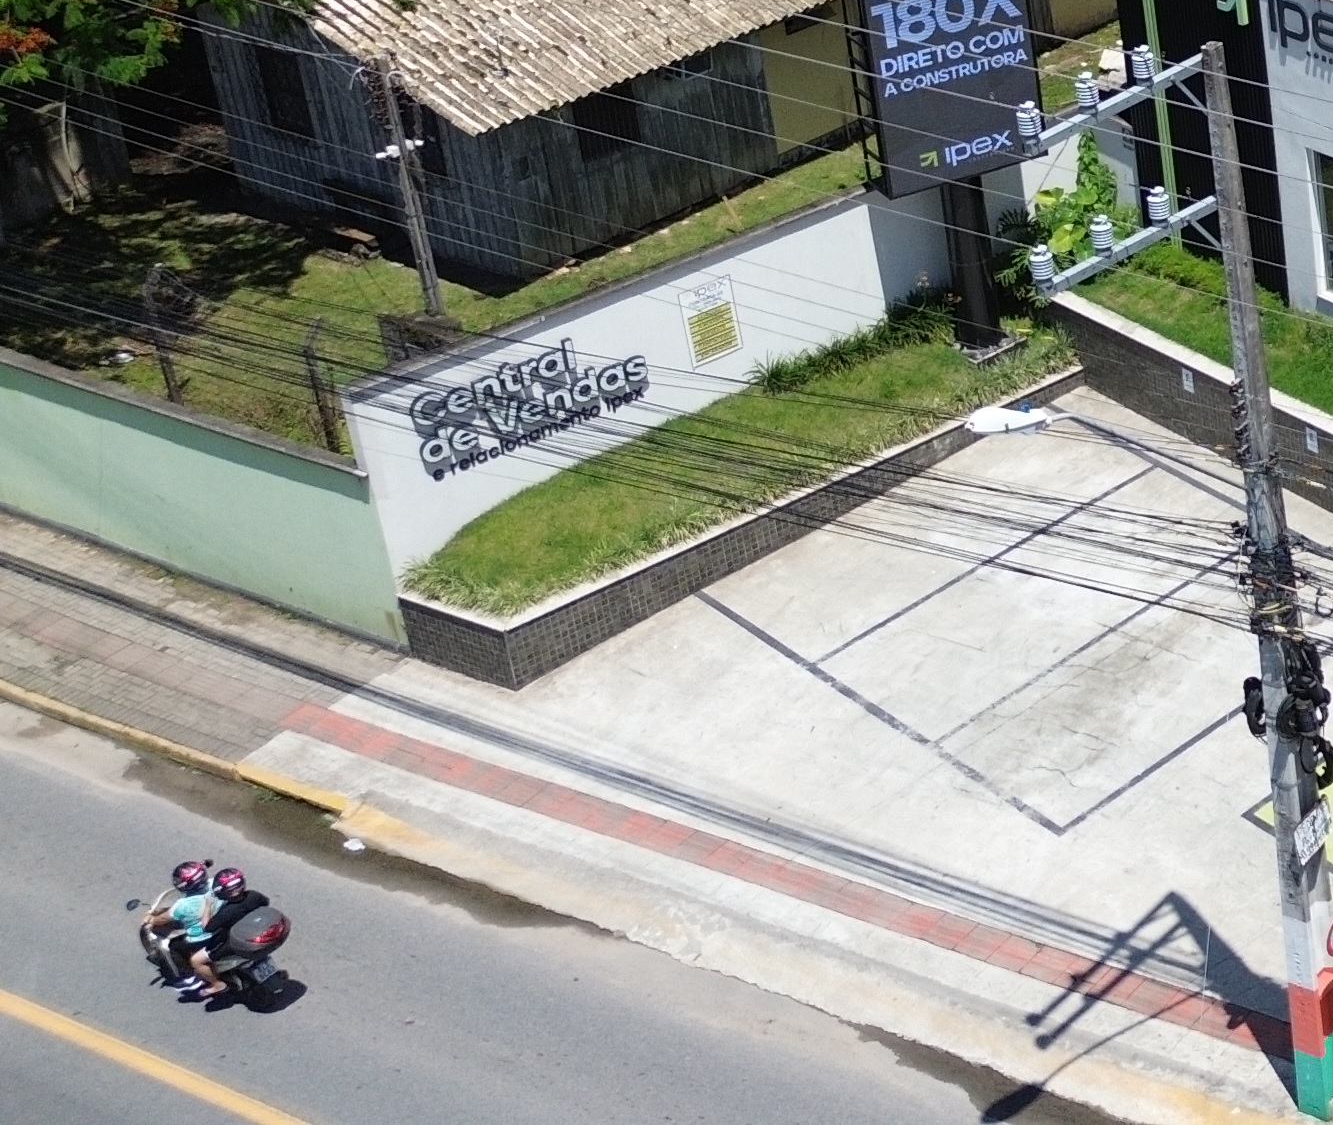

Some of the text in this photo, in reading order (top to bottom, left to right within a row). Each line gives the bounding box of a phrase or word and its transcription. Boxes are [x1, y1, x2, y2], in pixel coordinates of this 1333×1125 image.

[880, 25, 1025, 78] DIRETO COM
[884, 49, 1029, 98] A CONSTRUTORA
[410, 337, 577, 432] Central
[419, 355, 648, 467] de Vendas
[432, 466, 446, 482] e
[450, 404, 601, 475] relacionamento
